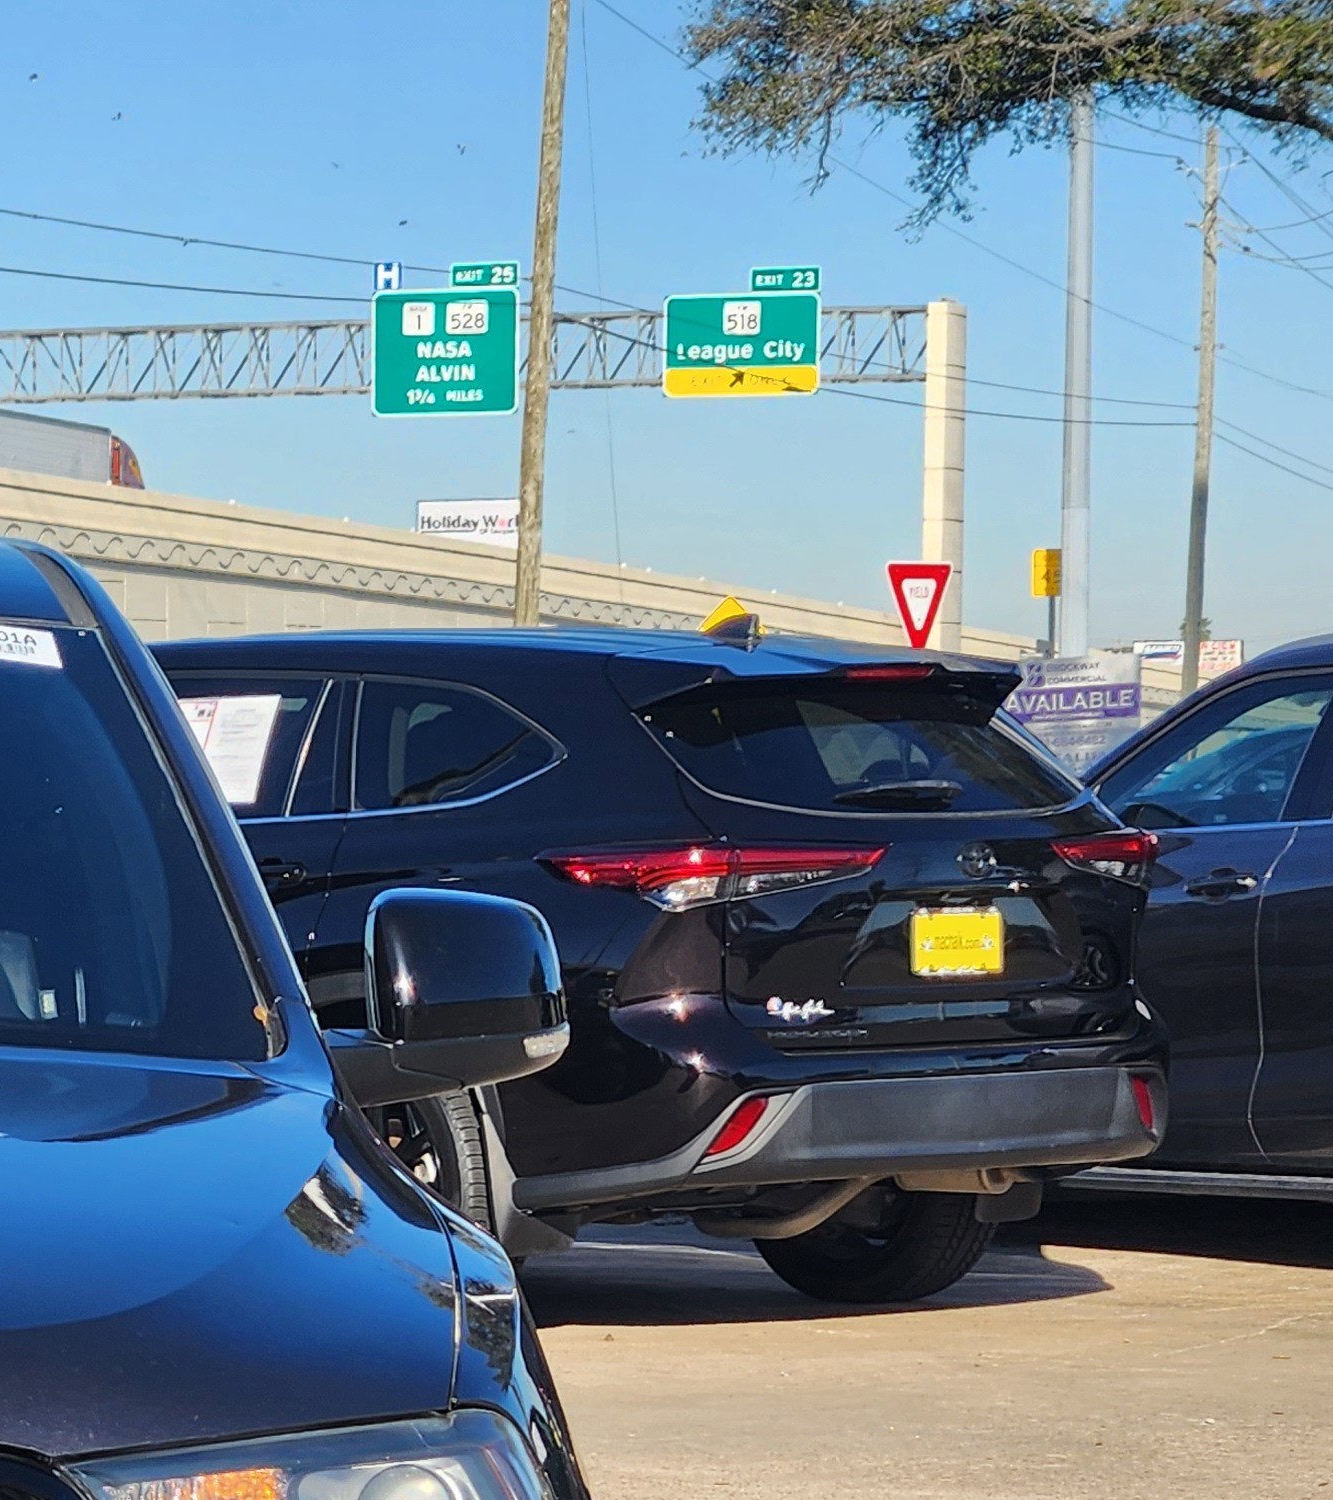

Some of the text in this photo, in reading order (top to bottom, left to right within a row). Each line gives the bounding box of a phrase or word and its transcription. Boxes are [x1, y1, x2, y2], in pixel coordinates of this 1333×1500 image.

[455, 266, 515, 283] EXIT 25
[755, 271, 815, 287] EXIT 23
[451, 312, 484, 329] 528
[727, 314, 758, 330] 518
[416, 341, 472, 358] NASA
[676, 339, 805, 364] League City
[415, 364, 476, 382] ALVIN
[445, 389, 484, 402] MILES
[420, 515, 479, 532] Holiday
[482, 514, 519, 528] Worl
[1006, 689, 1134, 714] AVAILABLE
